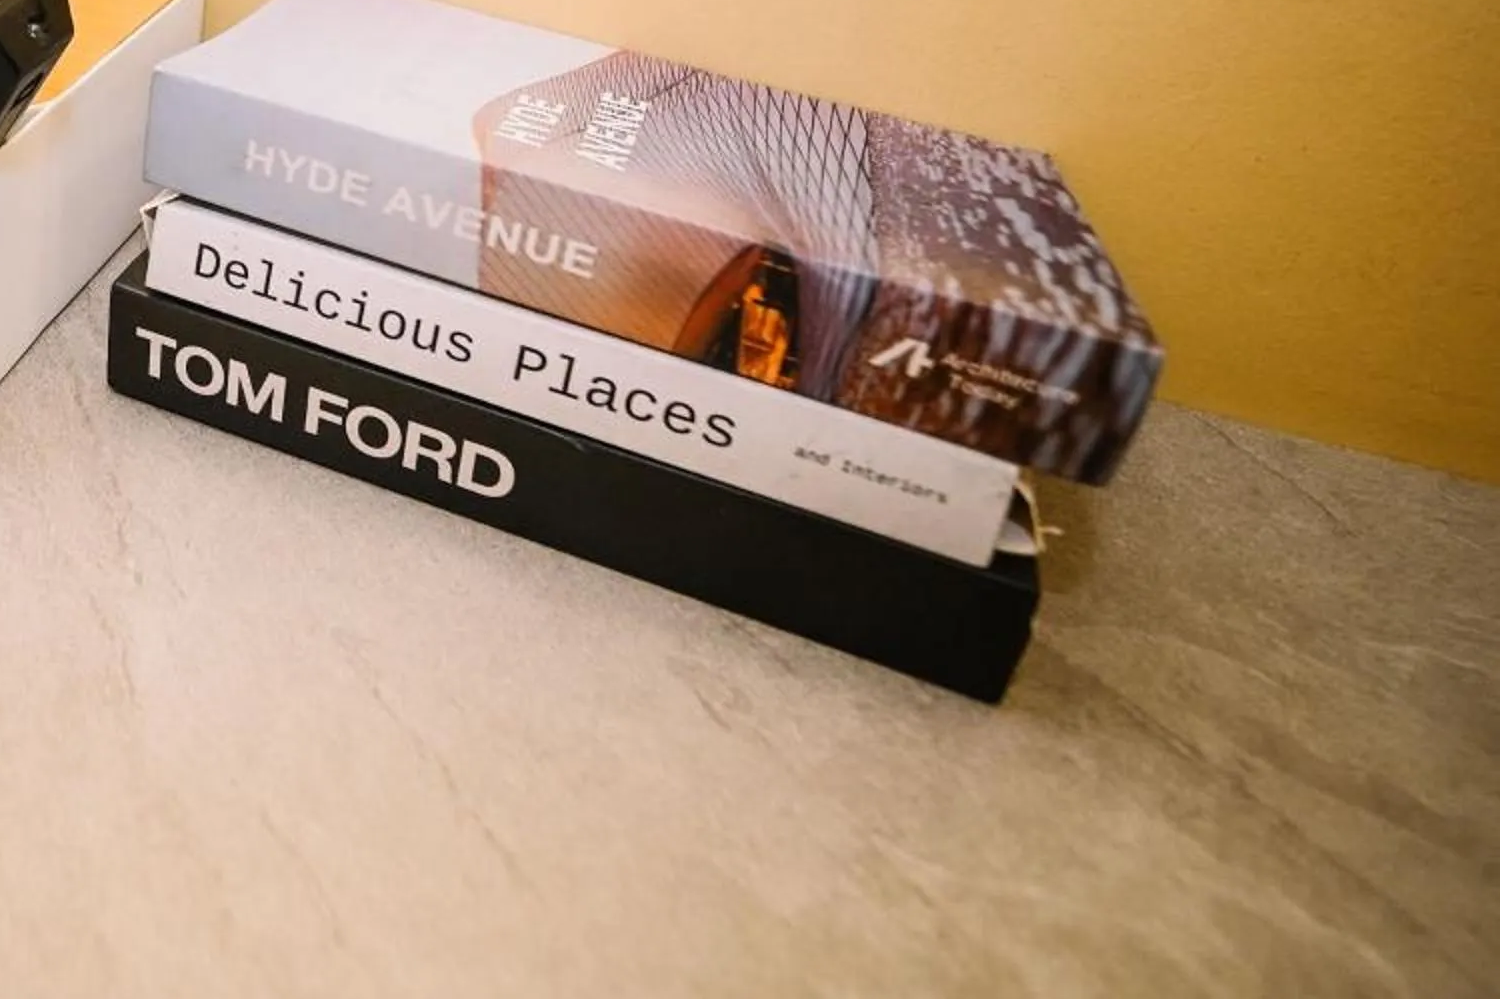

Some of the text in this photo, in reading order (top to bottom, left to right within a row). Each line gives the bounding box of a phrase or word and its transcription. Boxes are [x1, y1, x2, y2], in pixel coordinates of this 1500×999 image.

[244, 139, 599, 279] HYDE AVENUE
[136, 326, 516, 499] TOM FORD
[194, 243, 737, 448] Delicious Places
[794, 445, 949, 505] and Interiors
